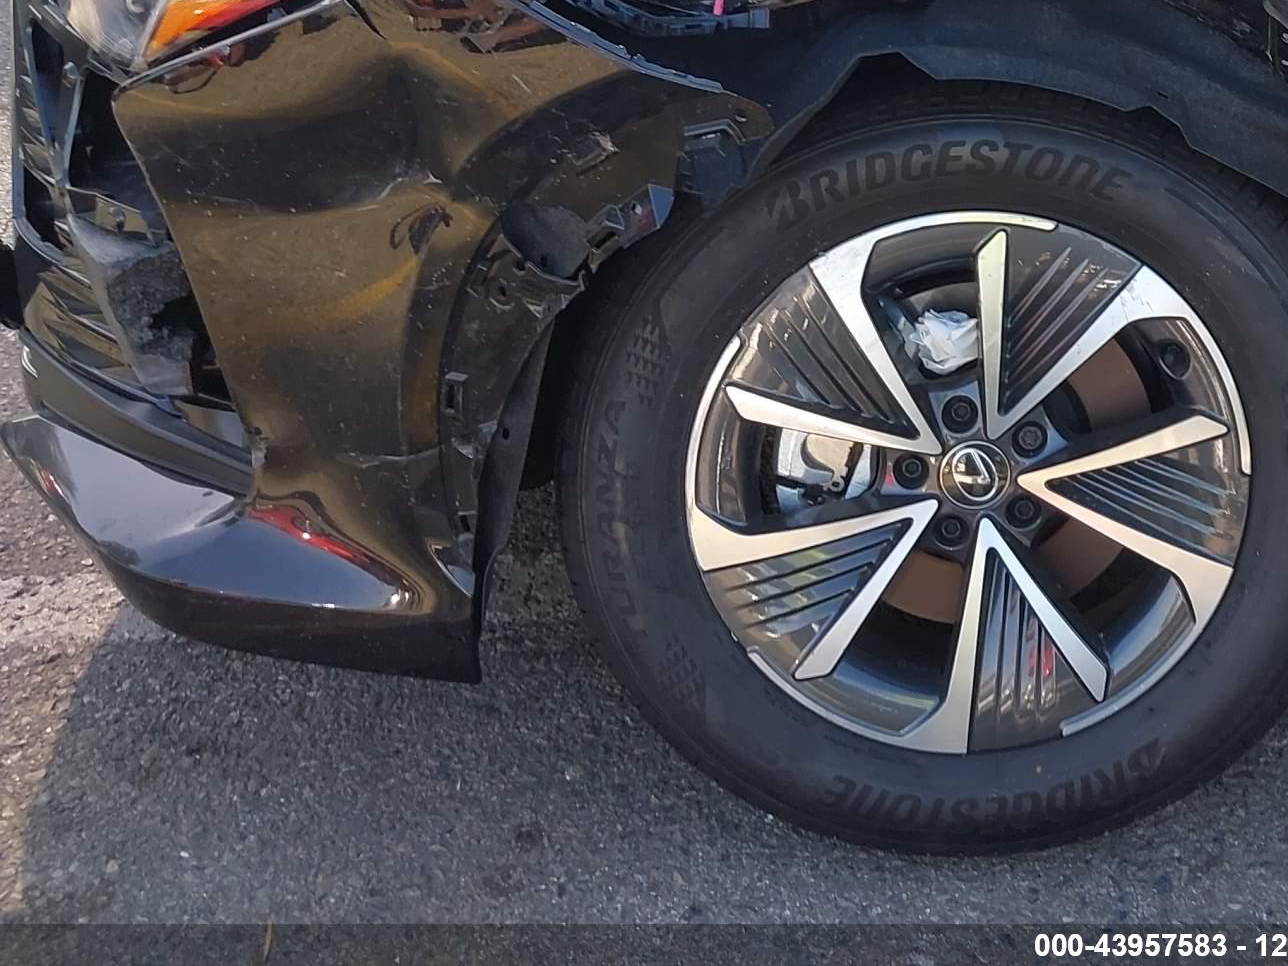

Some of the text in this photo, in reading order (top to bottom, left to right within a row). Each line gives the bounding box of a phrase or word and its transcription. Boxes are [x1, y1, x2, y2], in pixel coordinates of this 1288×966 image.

[764, 139, 1133, 232] BRIDGESTONE
[596, 400, 648, 650] TURANZA
[823, 737, 1167, 824] BRIDGESTONE
